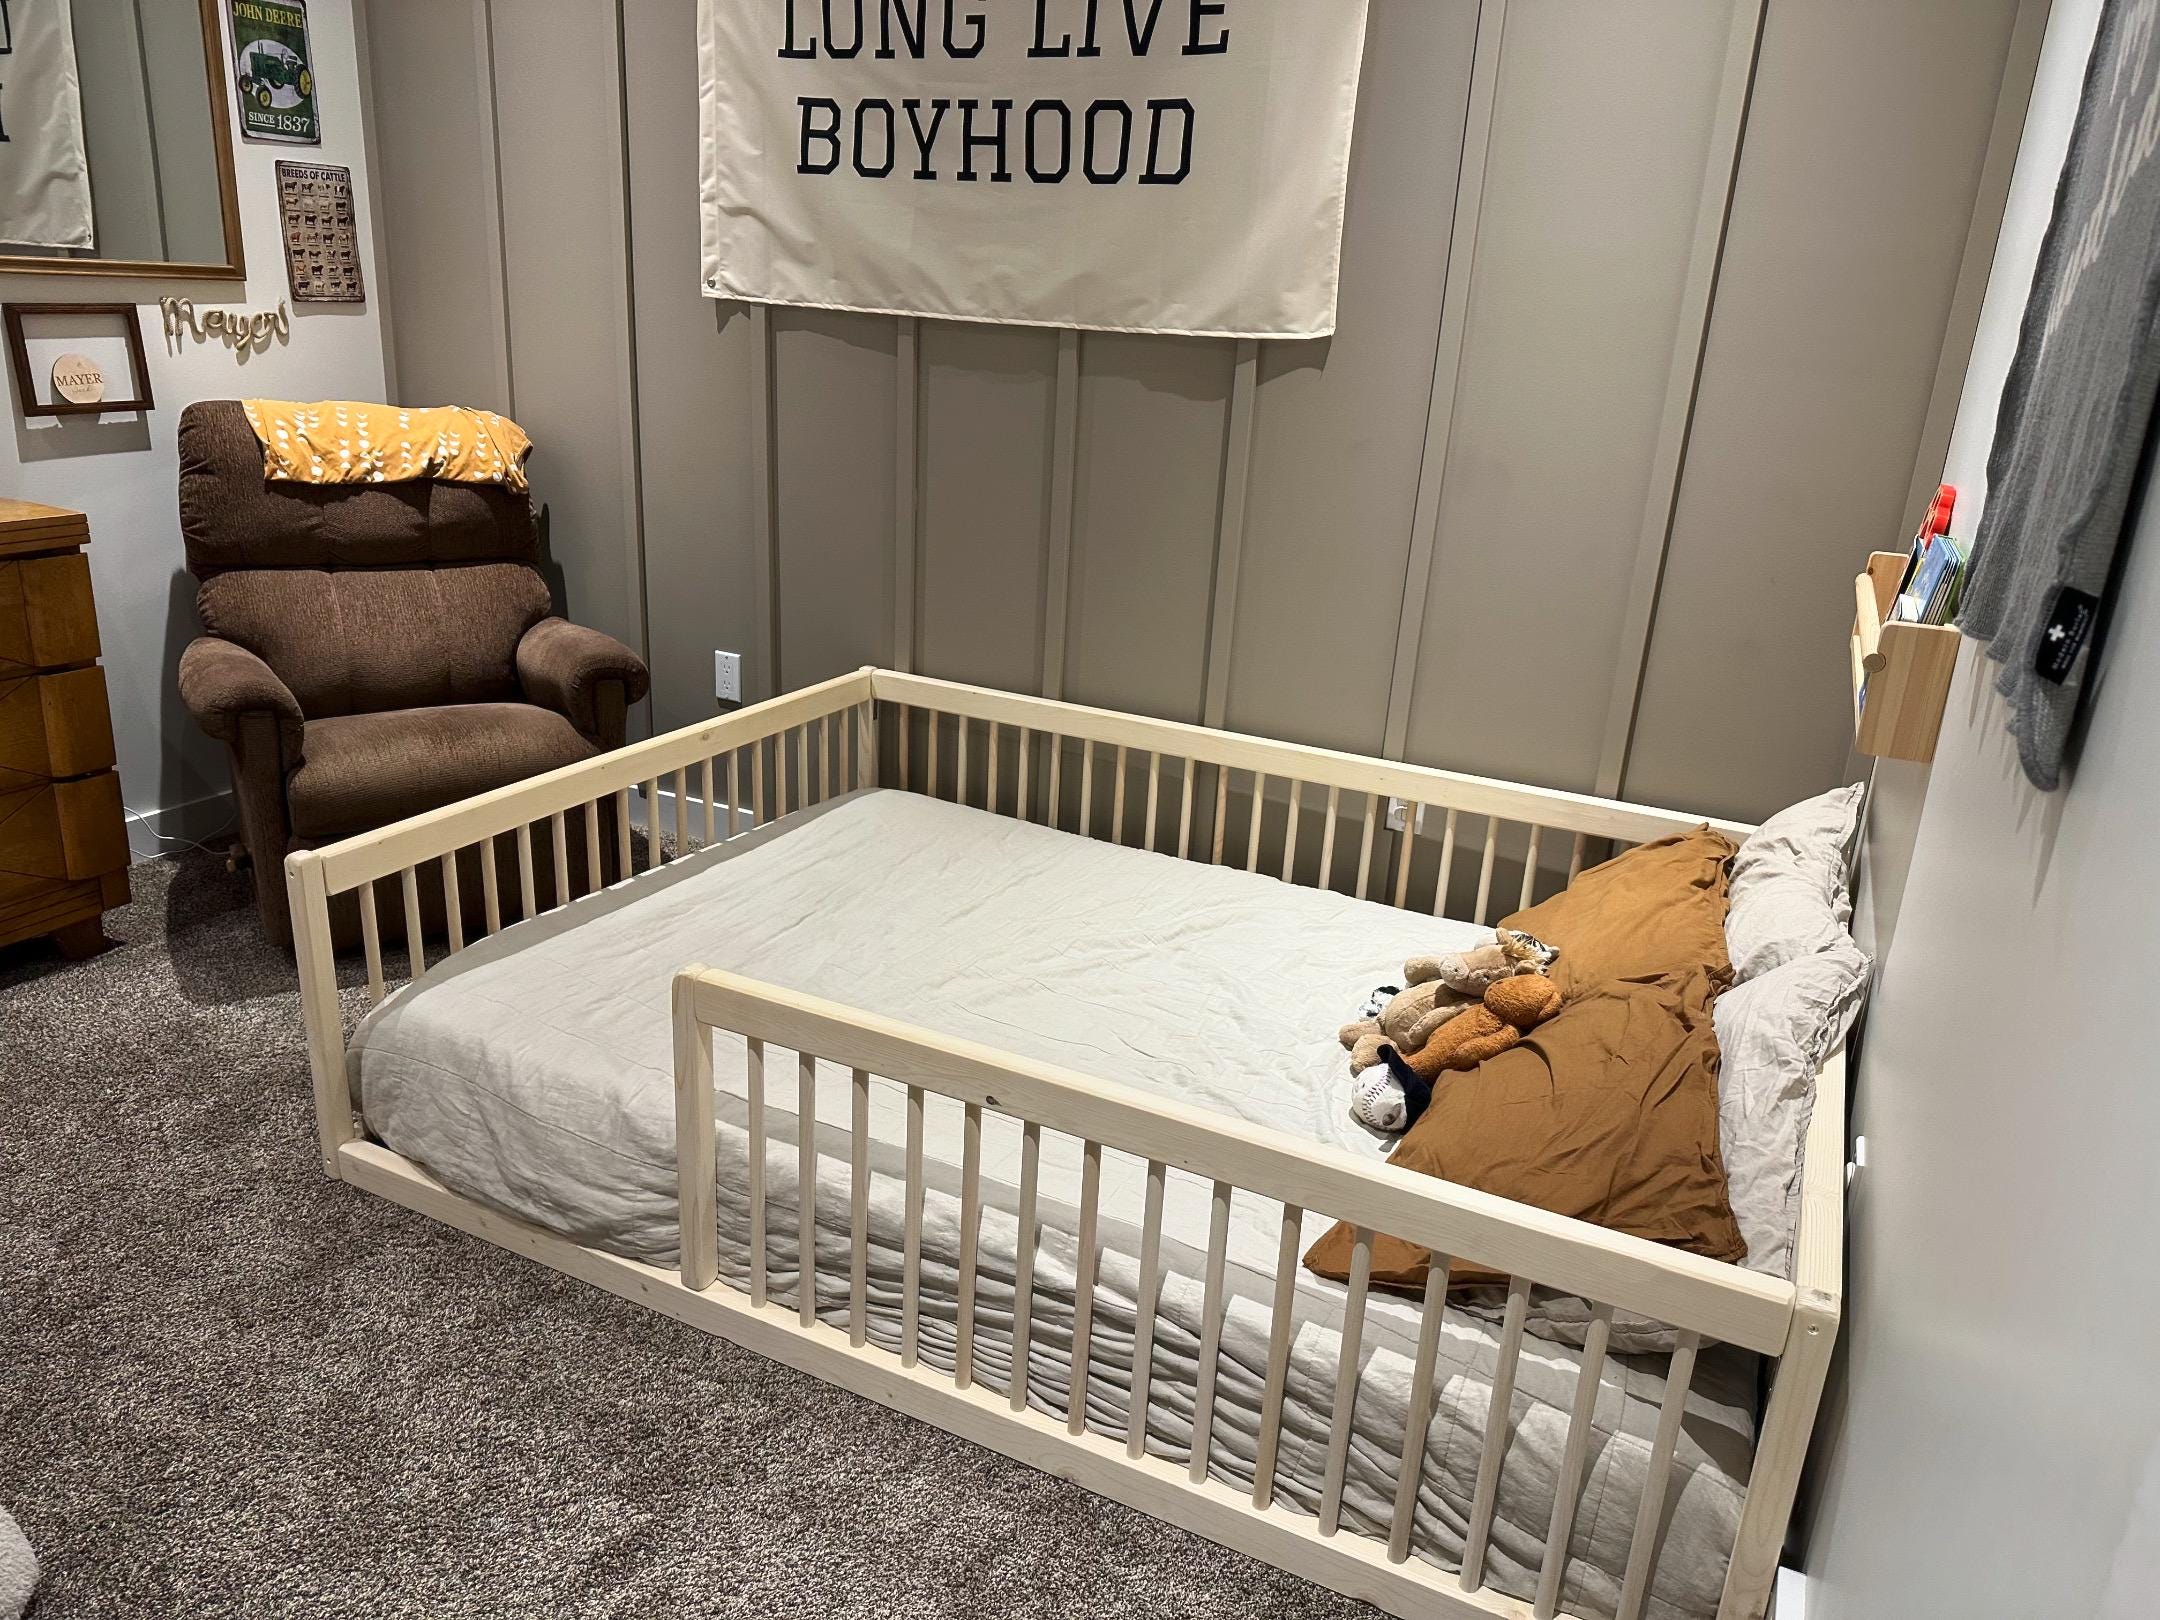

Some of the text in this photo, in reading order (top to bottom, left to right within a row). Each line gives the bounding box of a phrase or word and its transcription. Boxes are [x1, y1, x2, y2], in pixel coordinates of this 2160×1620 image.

[233, 1, 303, 28] JOHN DEERE
[777, 0, 1230, 59] LONG LIVE
[248, 111, 310, 132] SINCE 1837
[796, 96, 1195, 184] BOYHOOD
[281, 167, 346, 183] BREEDS OF CATTLE
[55, 373, 104, 387] MAYER
